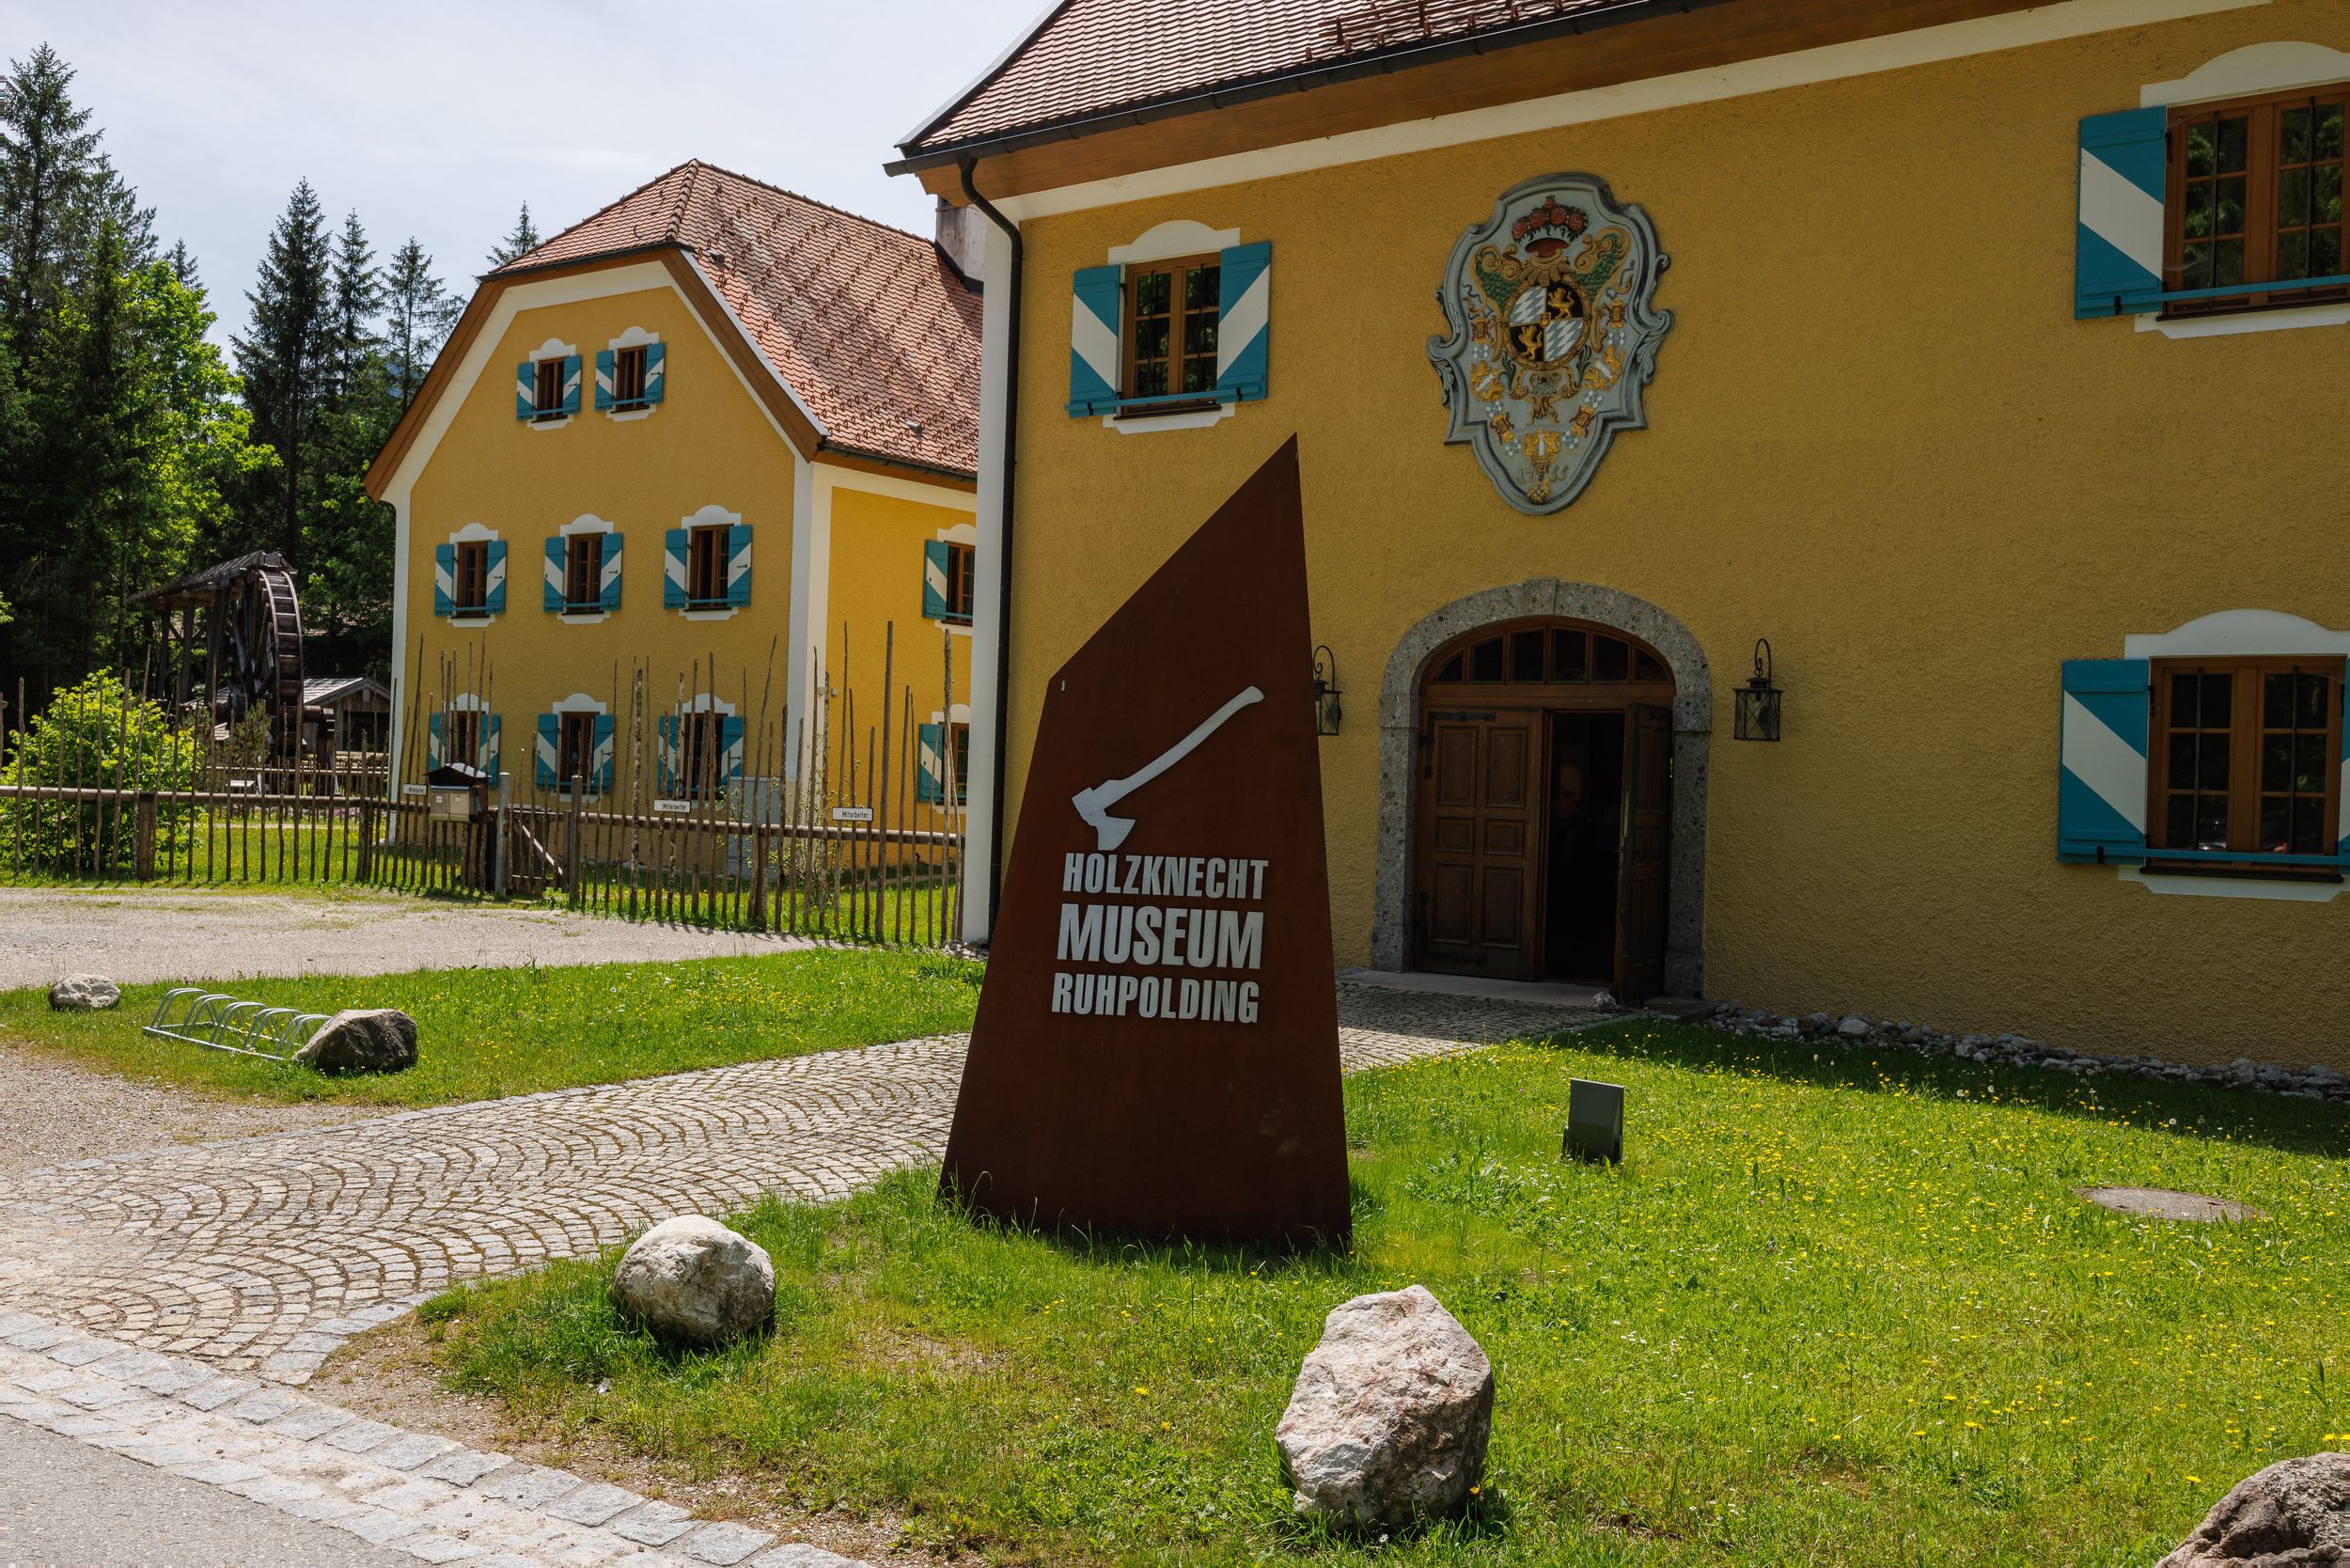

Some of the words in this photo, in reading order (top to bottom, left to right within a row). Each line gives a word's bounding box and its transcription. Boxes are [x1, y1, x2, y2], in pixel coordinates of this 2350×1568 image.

[1062, 853, 1269, 900] HOLZKNECHT
[1057, 903, 1264, 969] MUSEUM
[1051, 972, 1260, 1024] RUHPOLDING
